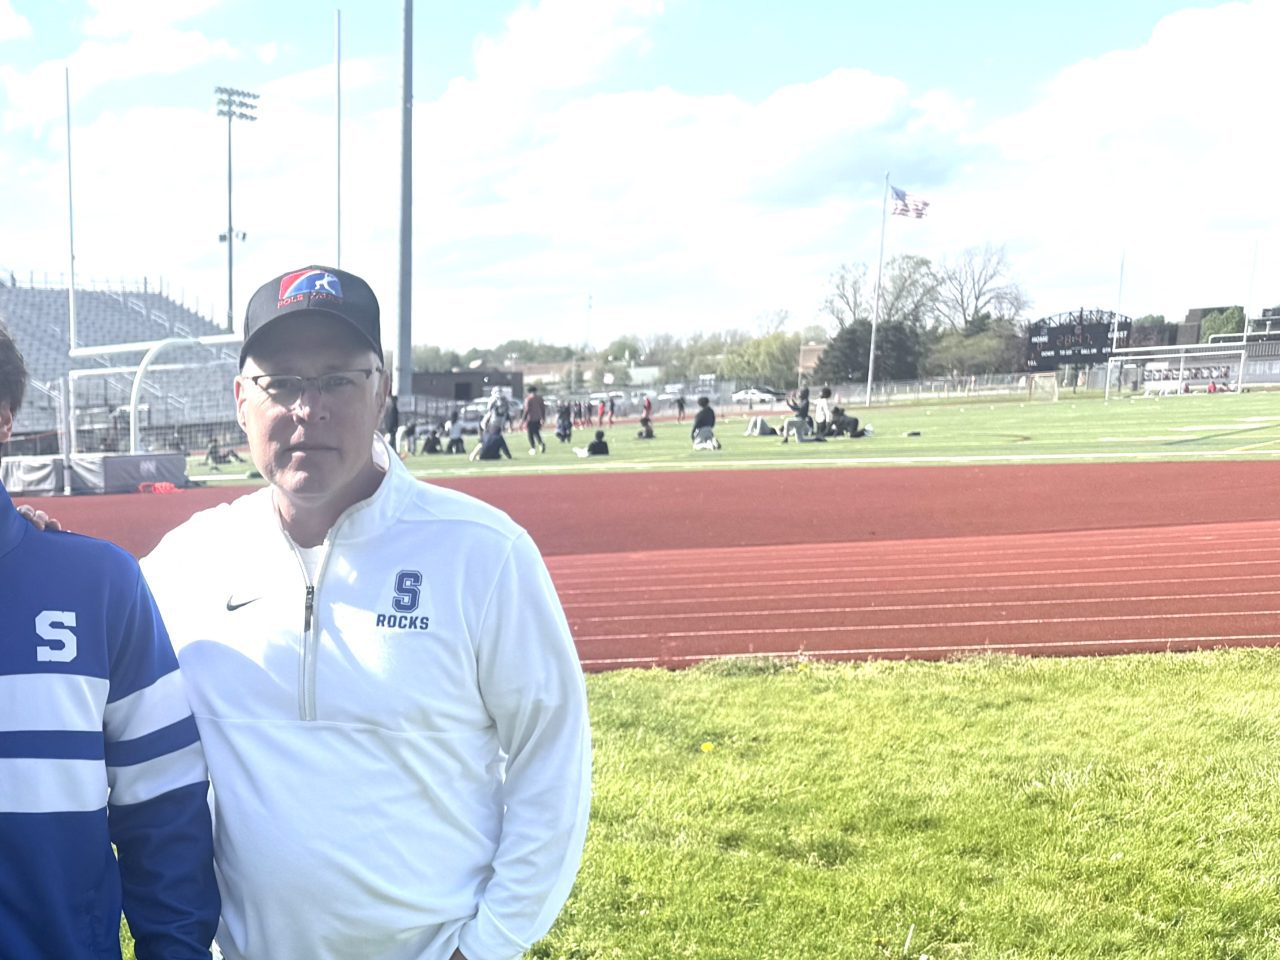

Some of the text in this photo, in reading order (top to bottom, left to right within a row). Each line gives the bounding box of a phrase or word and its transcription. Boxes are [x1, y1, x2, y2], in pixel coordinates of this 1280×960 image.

[391, 569, 423, 613] S
[35, 610, 77, 663] S
[375, 613, 429, 630] ROCKS
